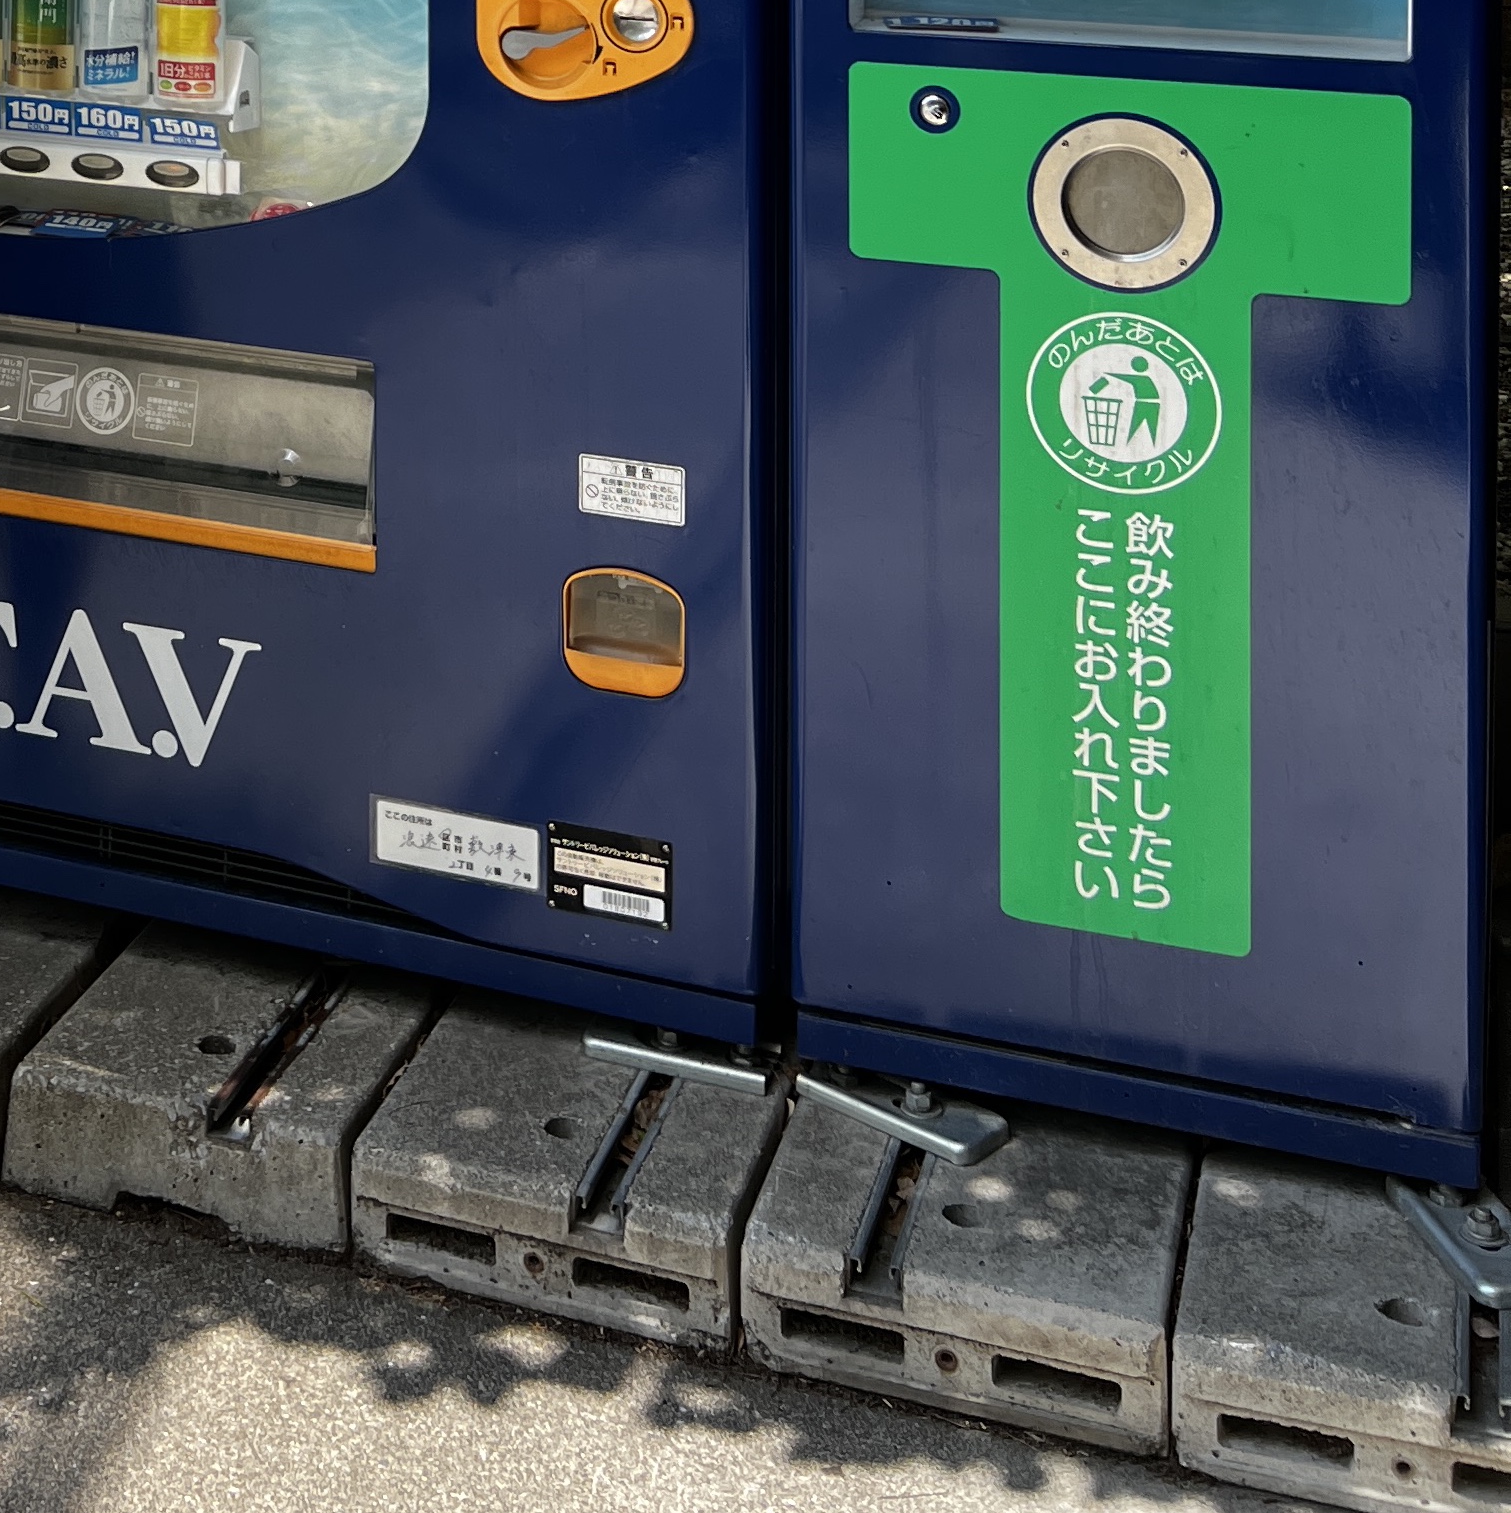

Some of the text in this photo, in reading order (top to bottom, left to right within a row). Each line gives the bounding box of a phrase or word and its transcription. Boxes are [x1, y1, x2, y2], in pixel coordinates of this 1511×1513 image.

[86, 51, 136, 68] 水分補給!
[86, 66, 131, 81] ミネラル!
[8, 101, 69, 123] 150円
[77, 107, 139, 130] 160円
[150, 117, 216, 138] 150円
[52, 215, 113, 229] 140円
[1047, 317, 1204, 386] のんだあとは
[1059, 438, 1193, 486] リサイクル
[1071, 508, 1121, 900] ここにお入れ下さい
[1124, 511, 1175, 911] 飲み終わりましたら
[384, 810, 433, 826] ここの住所は
